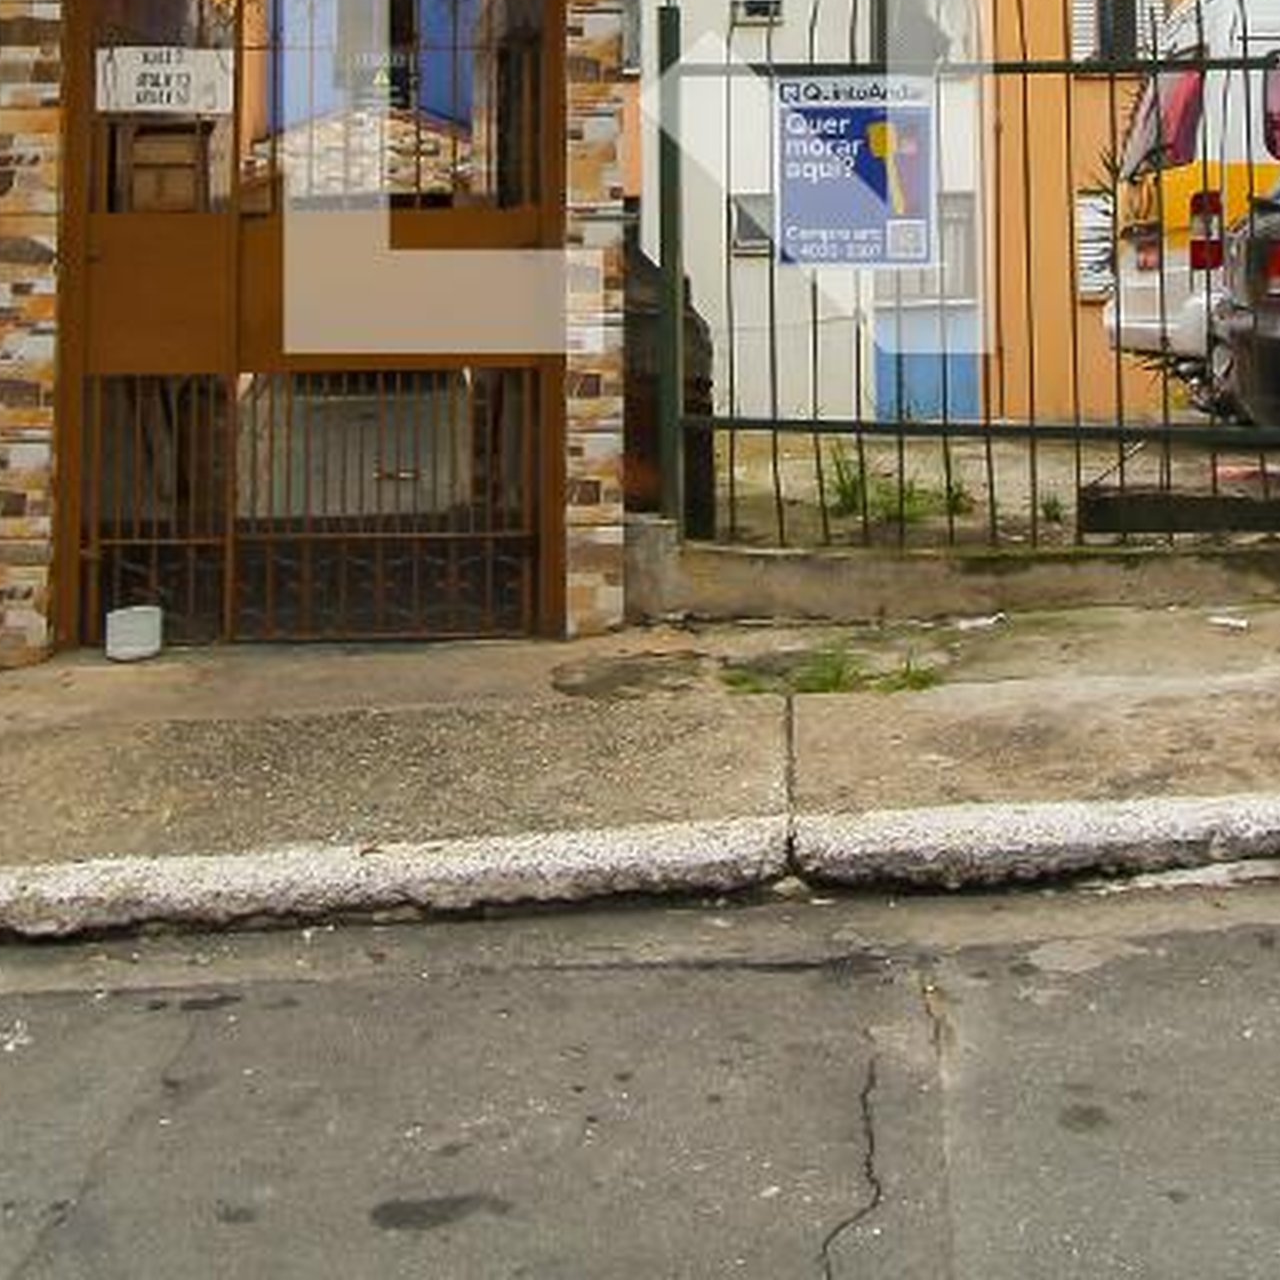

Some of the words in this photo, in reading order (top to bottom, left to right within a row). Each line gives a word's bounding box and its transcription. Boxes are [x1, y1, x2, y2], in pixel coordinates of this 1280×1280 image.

[785, 113, 851, 135] Quer
[785, 138, 865, 157] morar
[785, 156, 855, 184] aqui?
